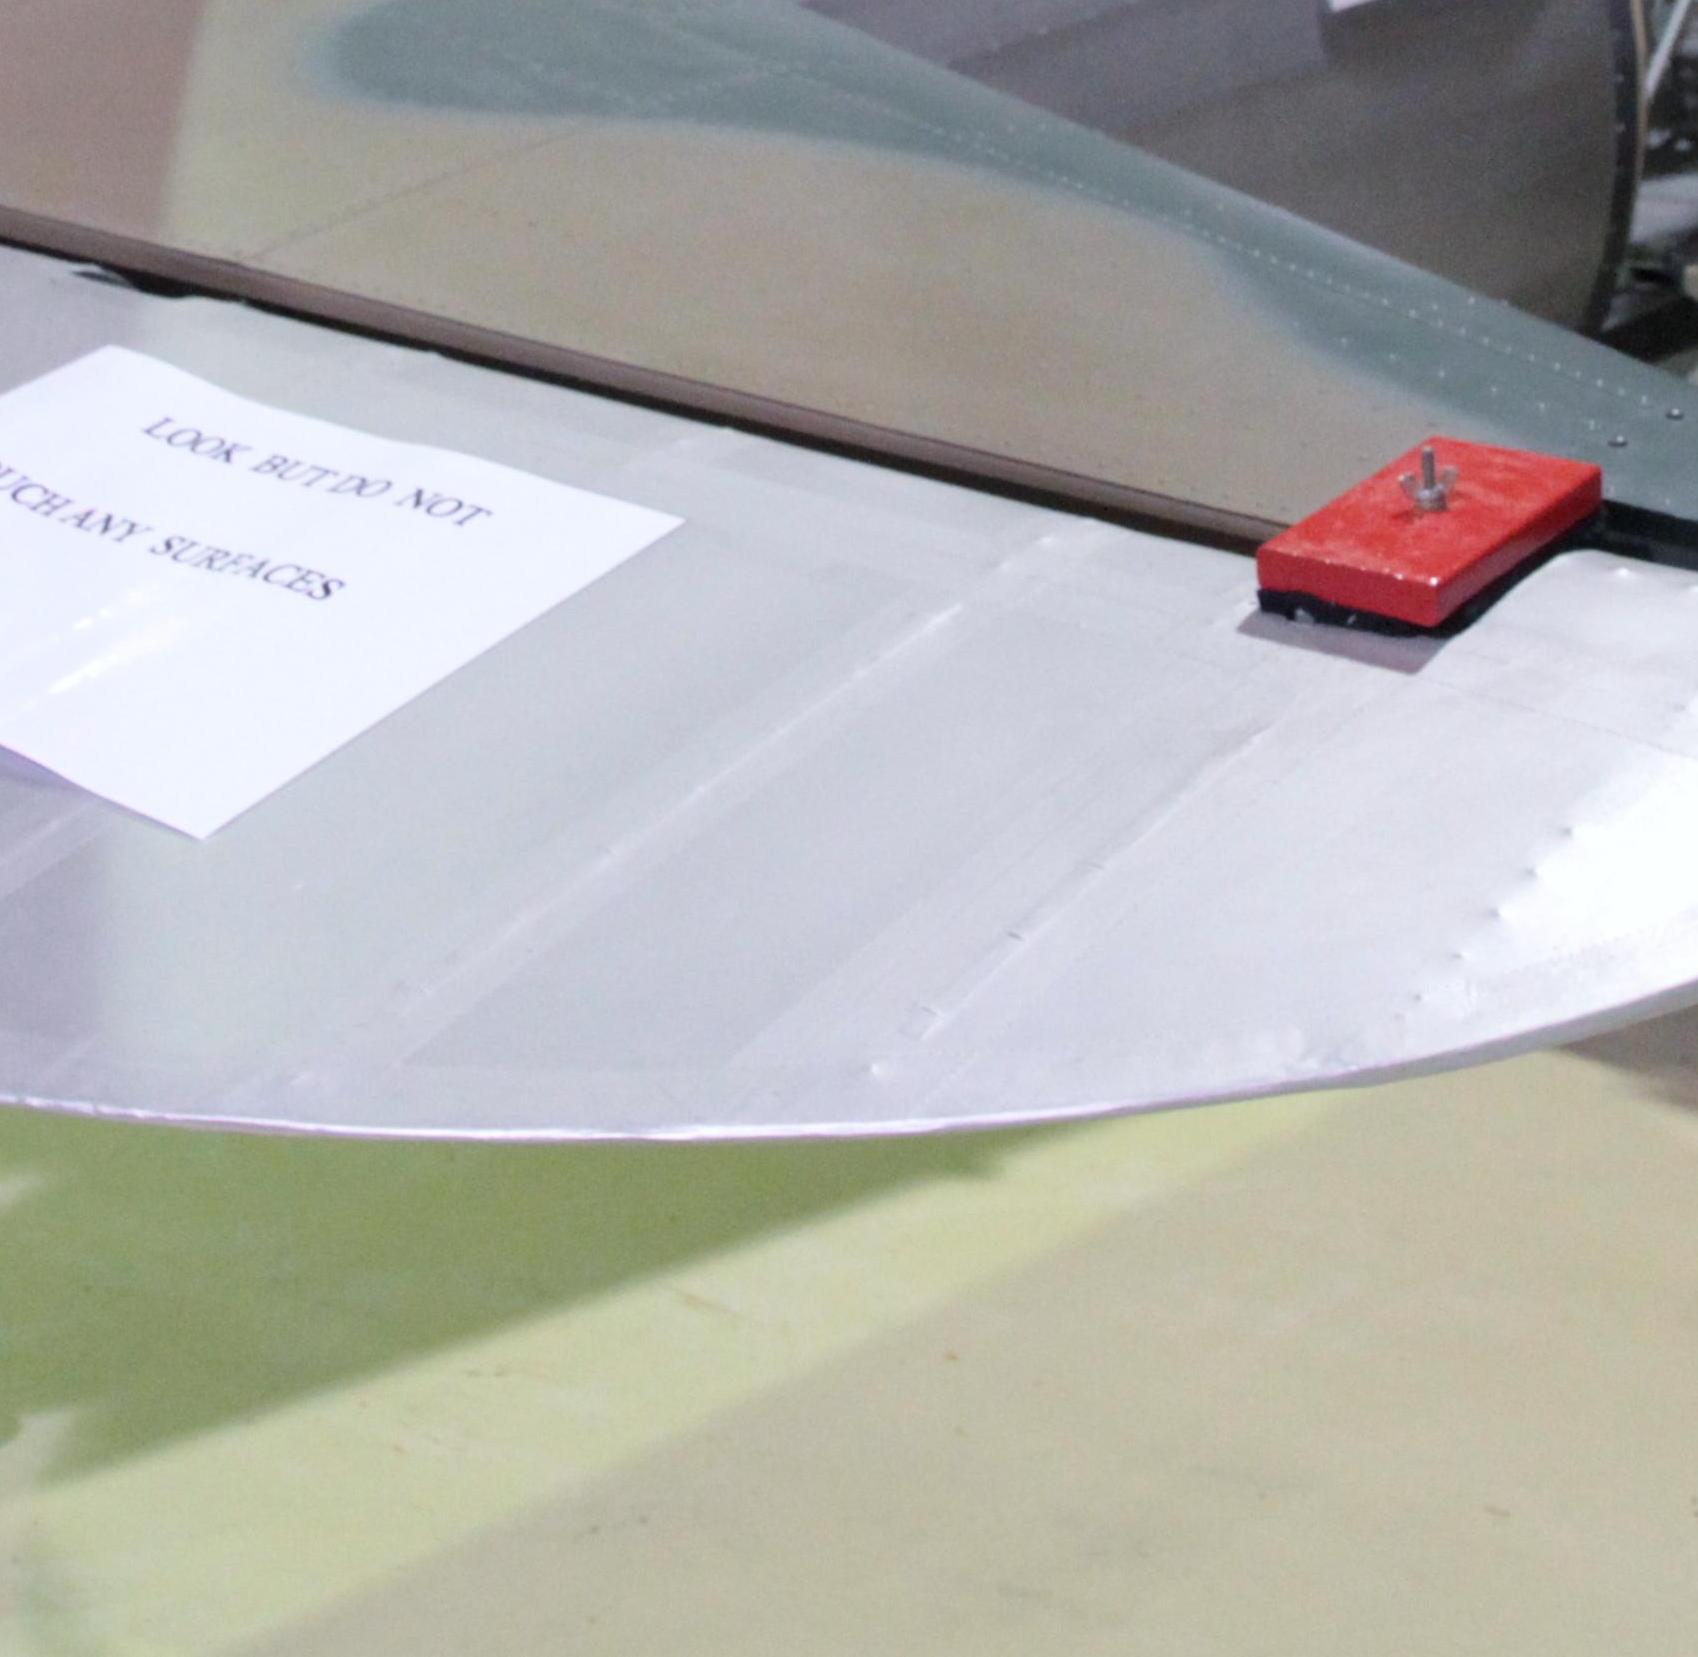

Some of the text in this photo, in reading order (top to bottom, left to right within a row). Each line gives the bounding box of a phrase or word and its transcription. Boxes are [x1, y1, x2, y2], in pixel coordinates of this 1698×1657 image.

[143, 416, 493, 526] LOOK BUT DO NOT
[58, 507, 153, 543] ANY
[149, 535, 346, 600] SURFACES
